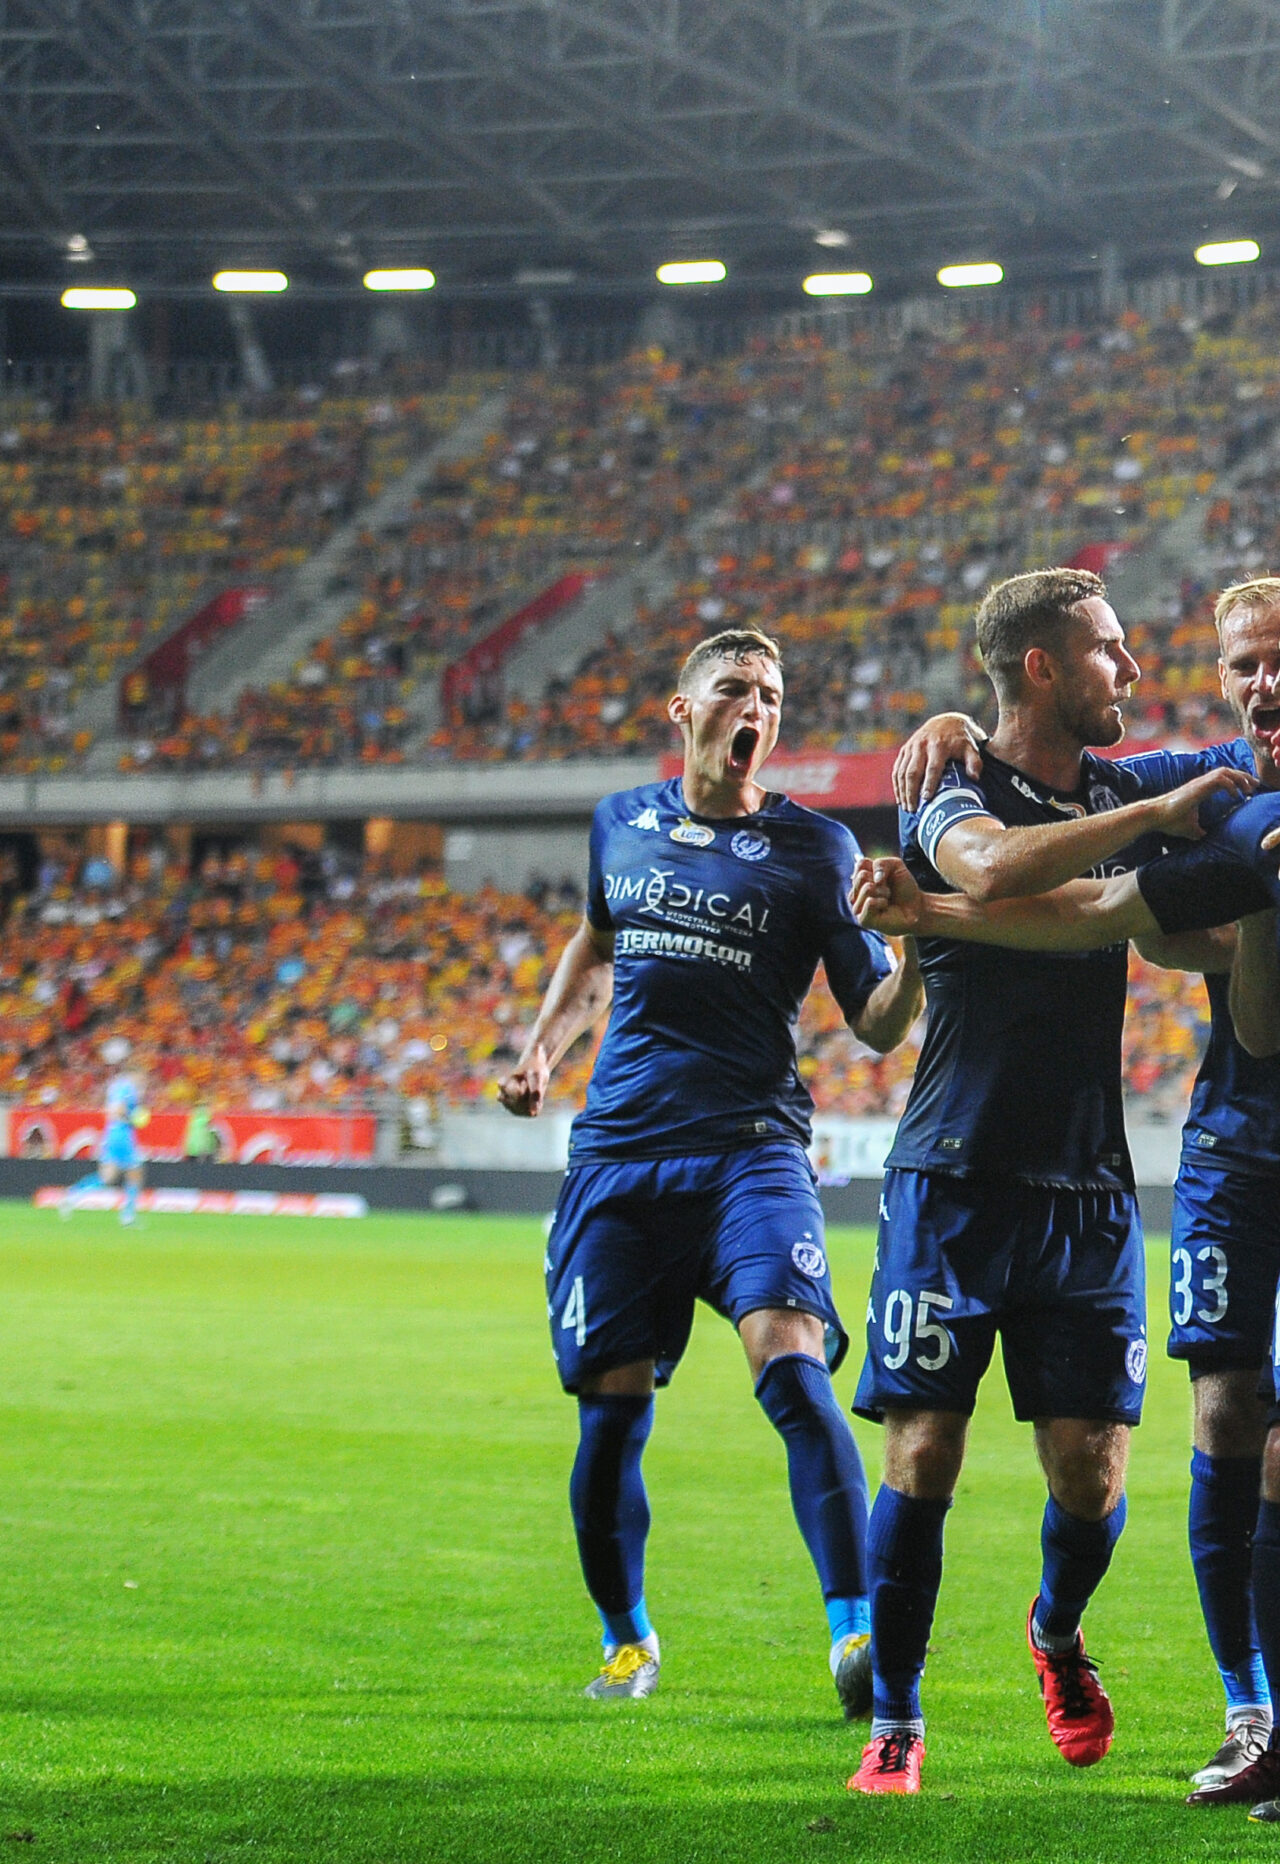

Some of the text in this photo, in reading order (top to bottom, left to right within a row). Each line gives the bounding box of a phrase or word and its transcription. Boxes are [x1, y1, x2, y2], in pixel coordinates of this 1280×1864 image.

[622, 928, 752, 967] TERMOton
[561, 1275, 585, 1346] 4
[1171, 1246, 1228, 1326] 33
[883, 1289, 953, 1371] 95
